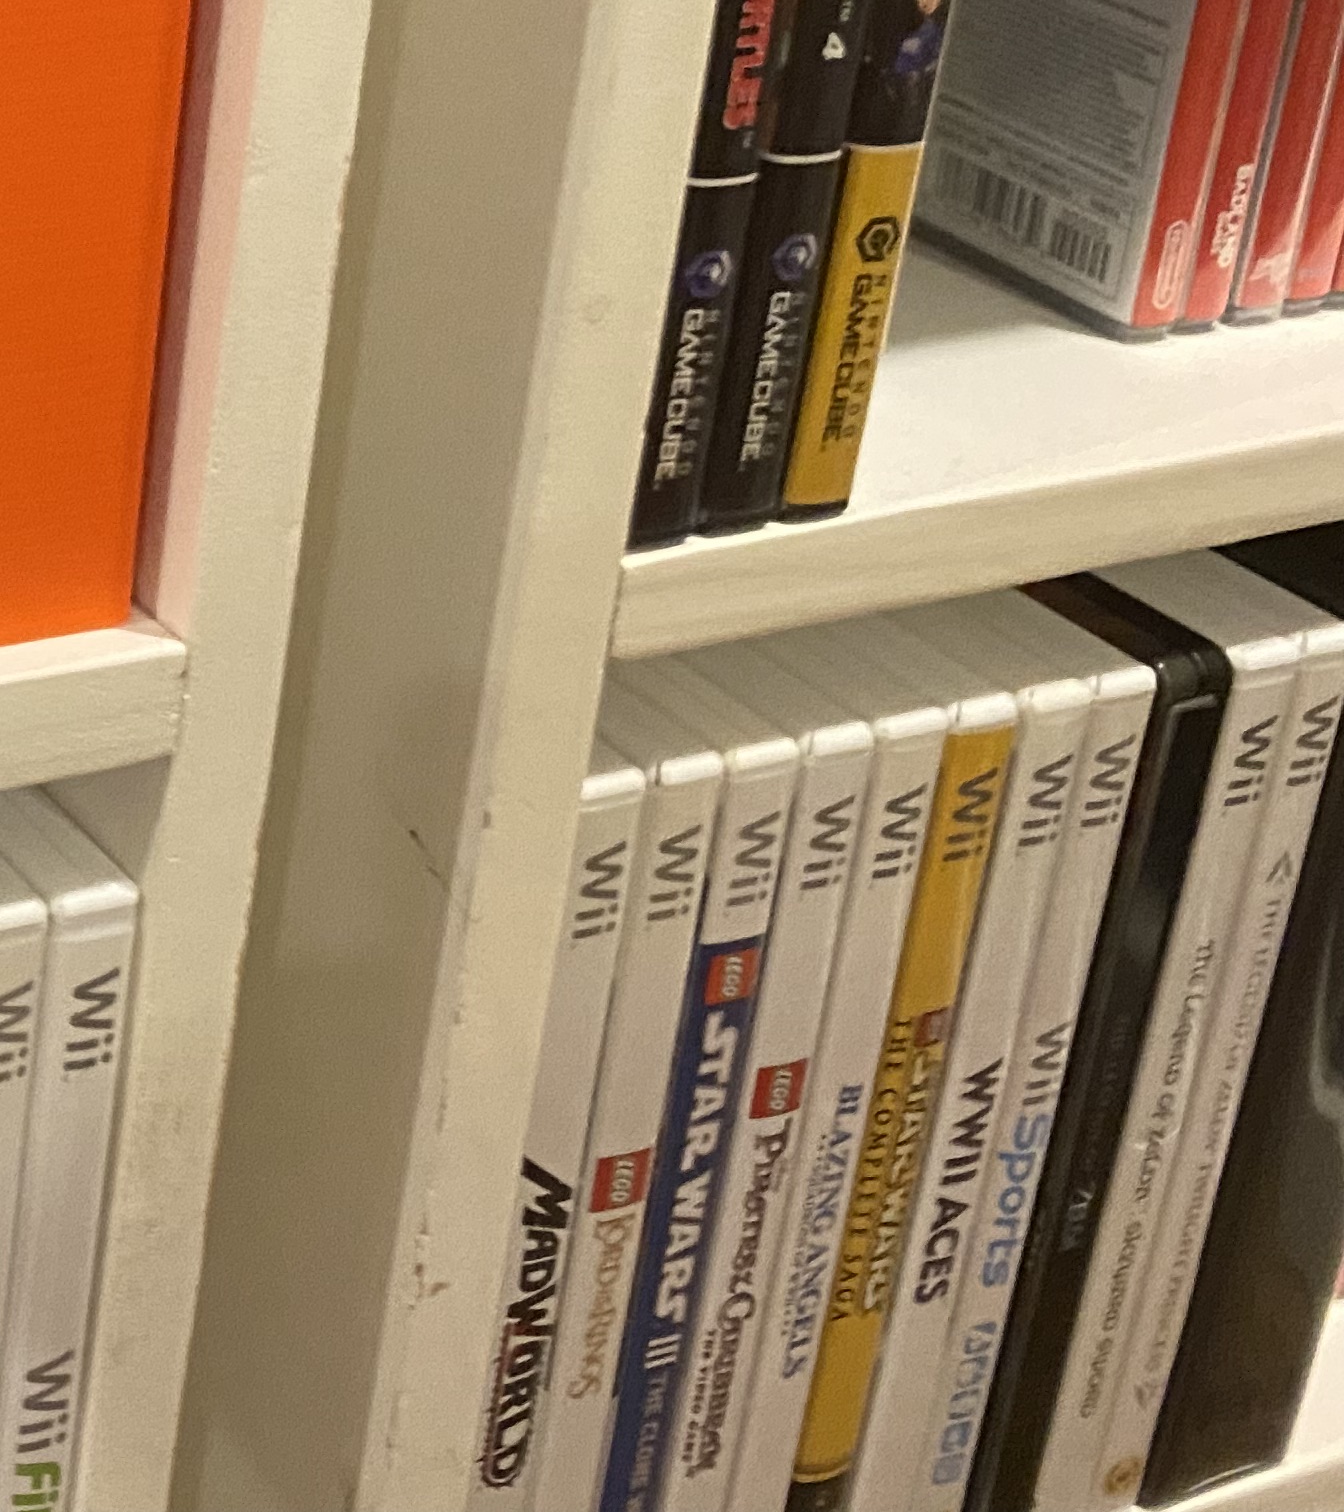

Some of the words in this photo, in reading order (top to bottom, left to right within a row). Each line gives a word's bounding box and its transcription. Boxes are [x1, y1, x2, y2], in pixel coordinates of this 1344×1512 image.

[822, 30, 846, 60] 4
[1080, 735, 1138, 831] Wii
[1223, 713, 1281, 809] Wii
[1285, 693, 1341, 789] Wii
[799, 793, 857, 892] Wii
[871, 782, 928, 882] Wii
[941, 766, 1000, 864] Wii
[1015, 752, 1075, 850] Wii
[571, 841, 628, 941] Wii
[645, 822, 704, 926] Wii
[726, 809, 781, 909] Wii
[63, 965, 122, 1072] Wii
[884, 1018, 913, 1071] THE
[679, 1009, 740, 1173] STAR
[940, 1056, 1005, 1186] WWII
[811, 1084, 864, 1237] BLAZING
[849, 1087, 899, 1238] COMPLETE
[981, 1113, 1054, 1289] Sports
[654, 1167, 713, 1324] WARS
[830, 1253, 862, 1322] SAGA
[912, 1196, 969, 1305] ACES
[781, 1243, 831, 1380] ANGELS
[16, 1348, 76, 1454] Wii
